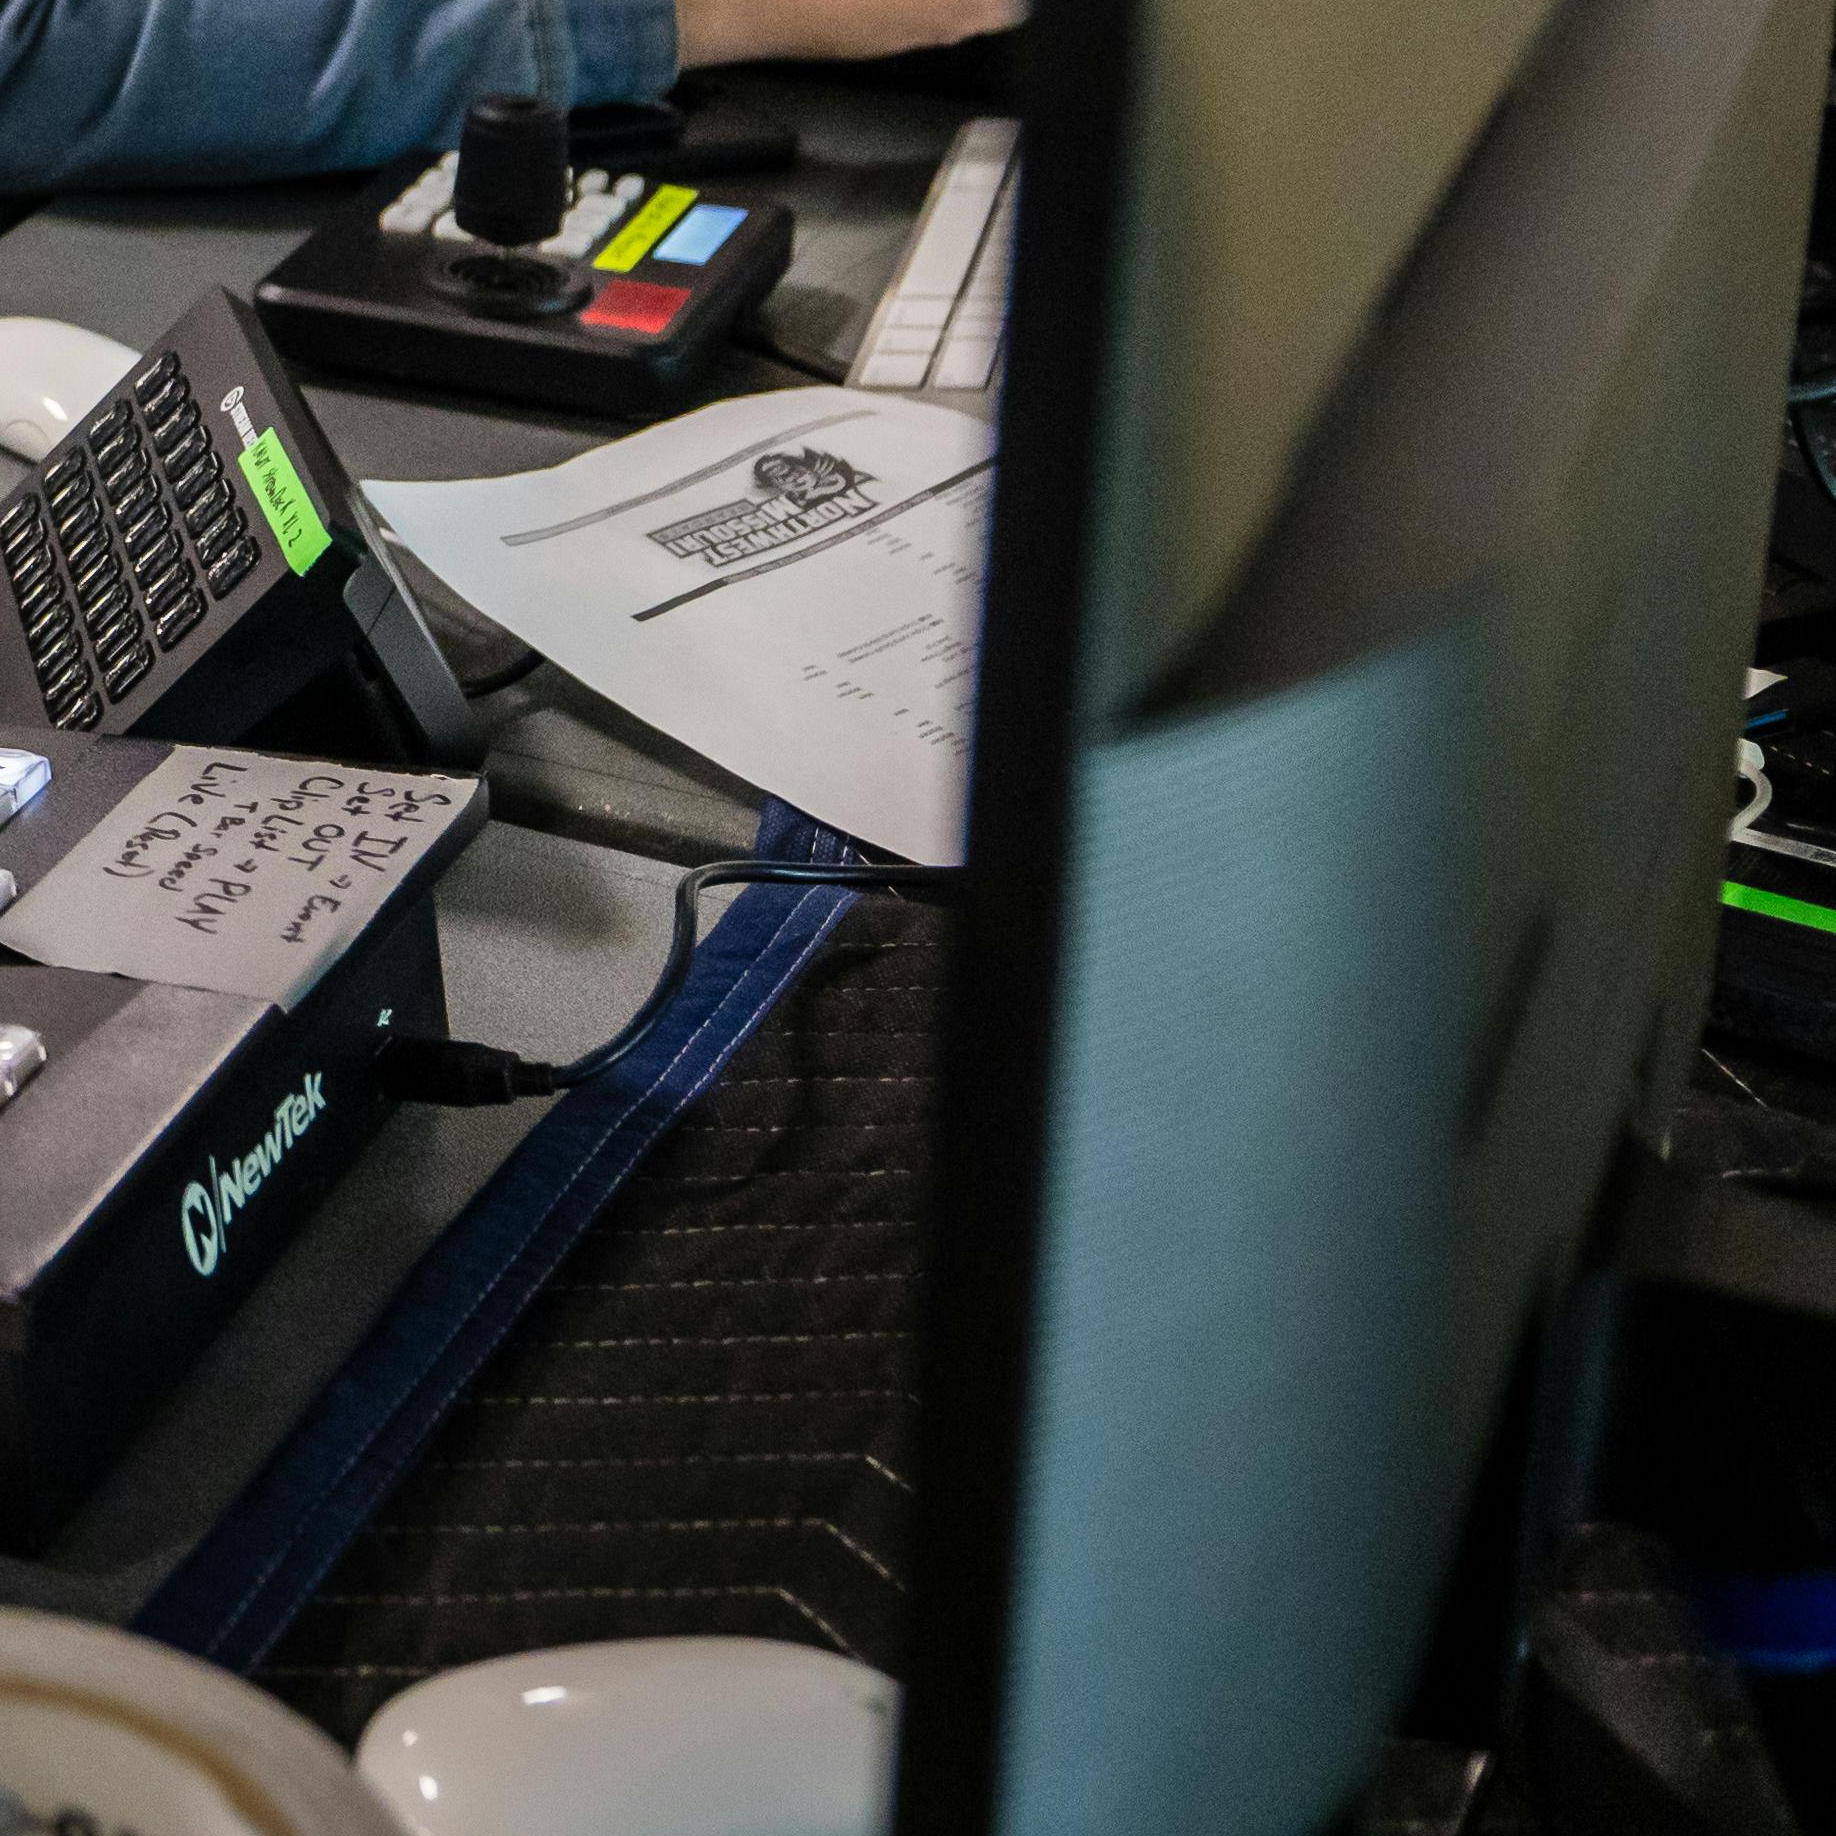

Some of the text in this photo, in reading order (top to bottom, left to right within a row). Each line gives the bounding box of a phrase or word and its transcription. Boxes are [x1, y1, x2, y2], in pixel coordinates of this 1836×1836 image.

[287, 527, 304, 549] 2
[664, 494, 803, 559] MISSOURI
[704, 487, 877, 567] NORTHWEST
[178, 762, 249, 808] Live
[384, 789, 452, 824] Set
[175, 775, 345, 935] Clip List PLAY
[287, 780, 396, 872] Set OUT
[349, 830, 410, 873] IN
[158, 843, 219, 894] Speed
[219, 1071, 327, 1225] NewTek
